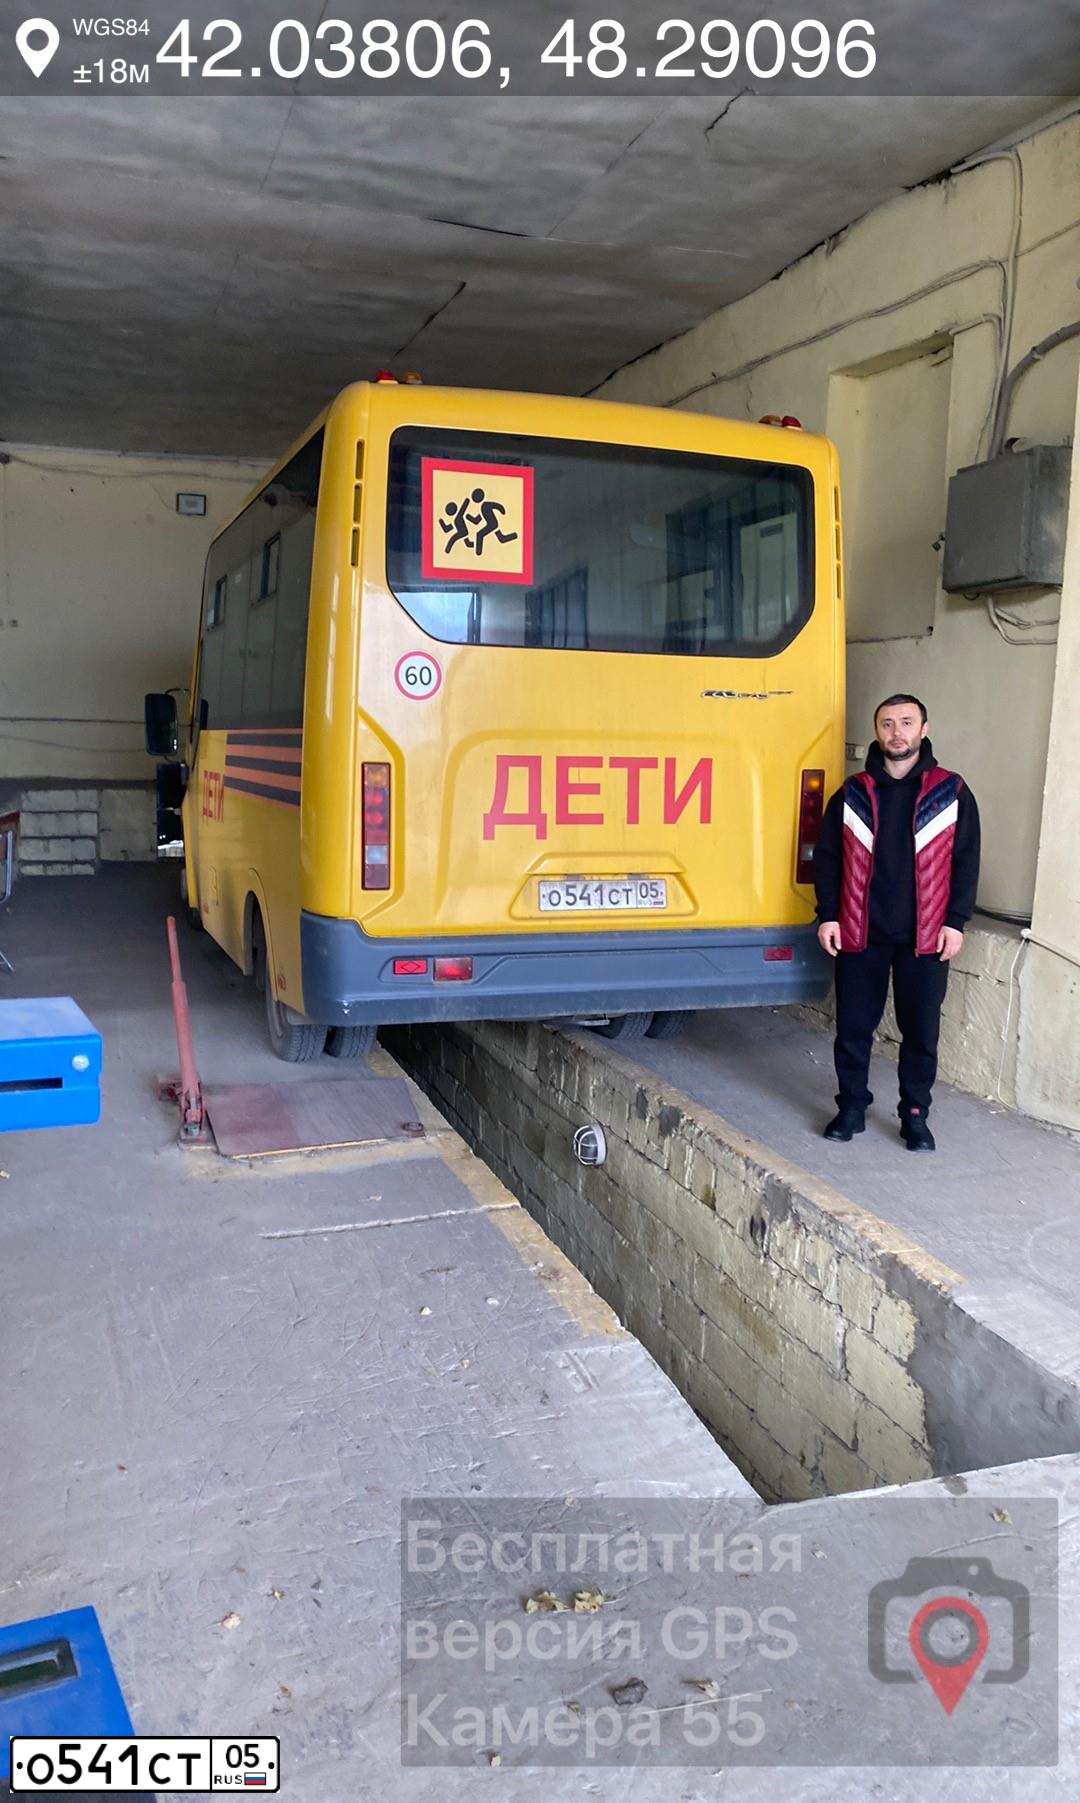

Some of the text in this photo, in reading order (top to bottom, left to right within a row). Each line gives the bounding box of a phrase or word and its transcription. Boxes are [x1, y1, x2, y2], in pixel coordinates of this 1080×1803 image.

[404, 664, 433, 687] 60
[483, 754, 713, 840] ДЕТИ
[638, 881, 660, 899] 05
